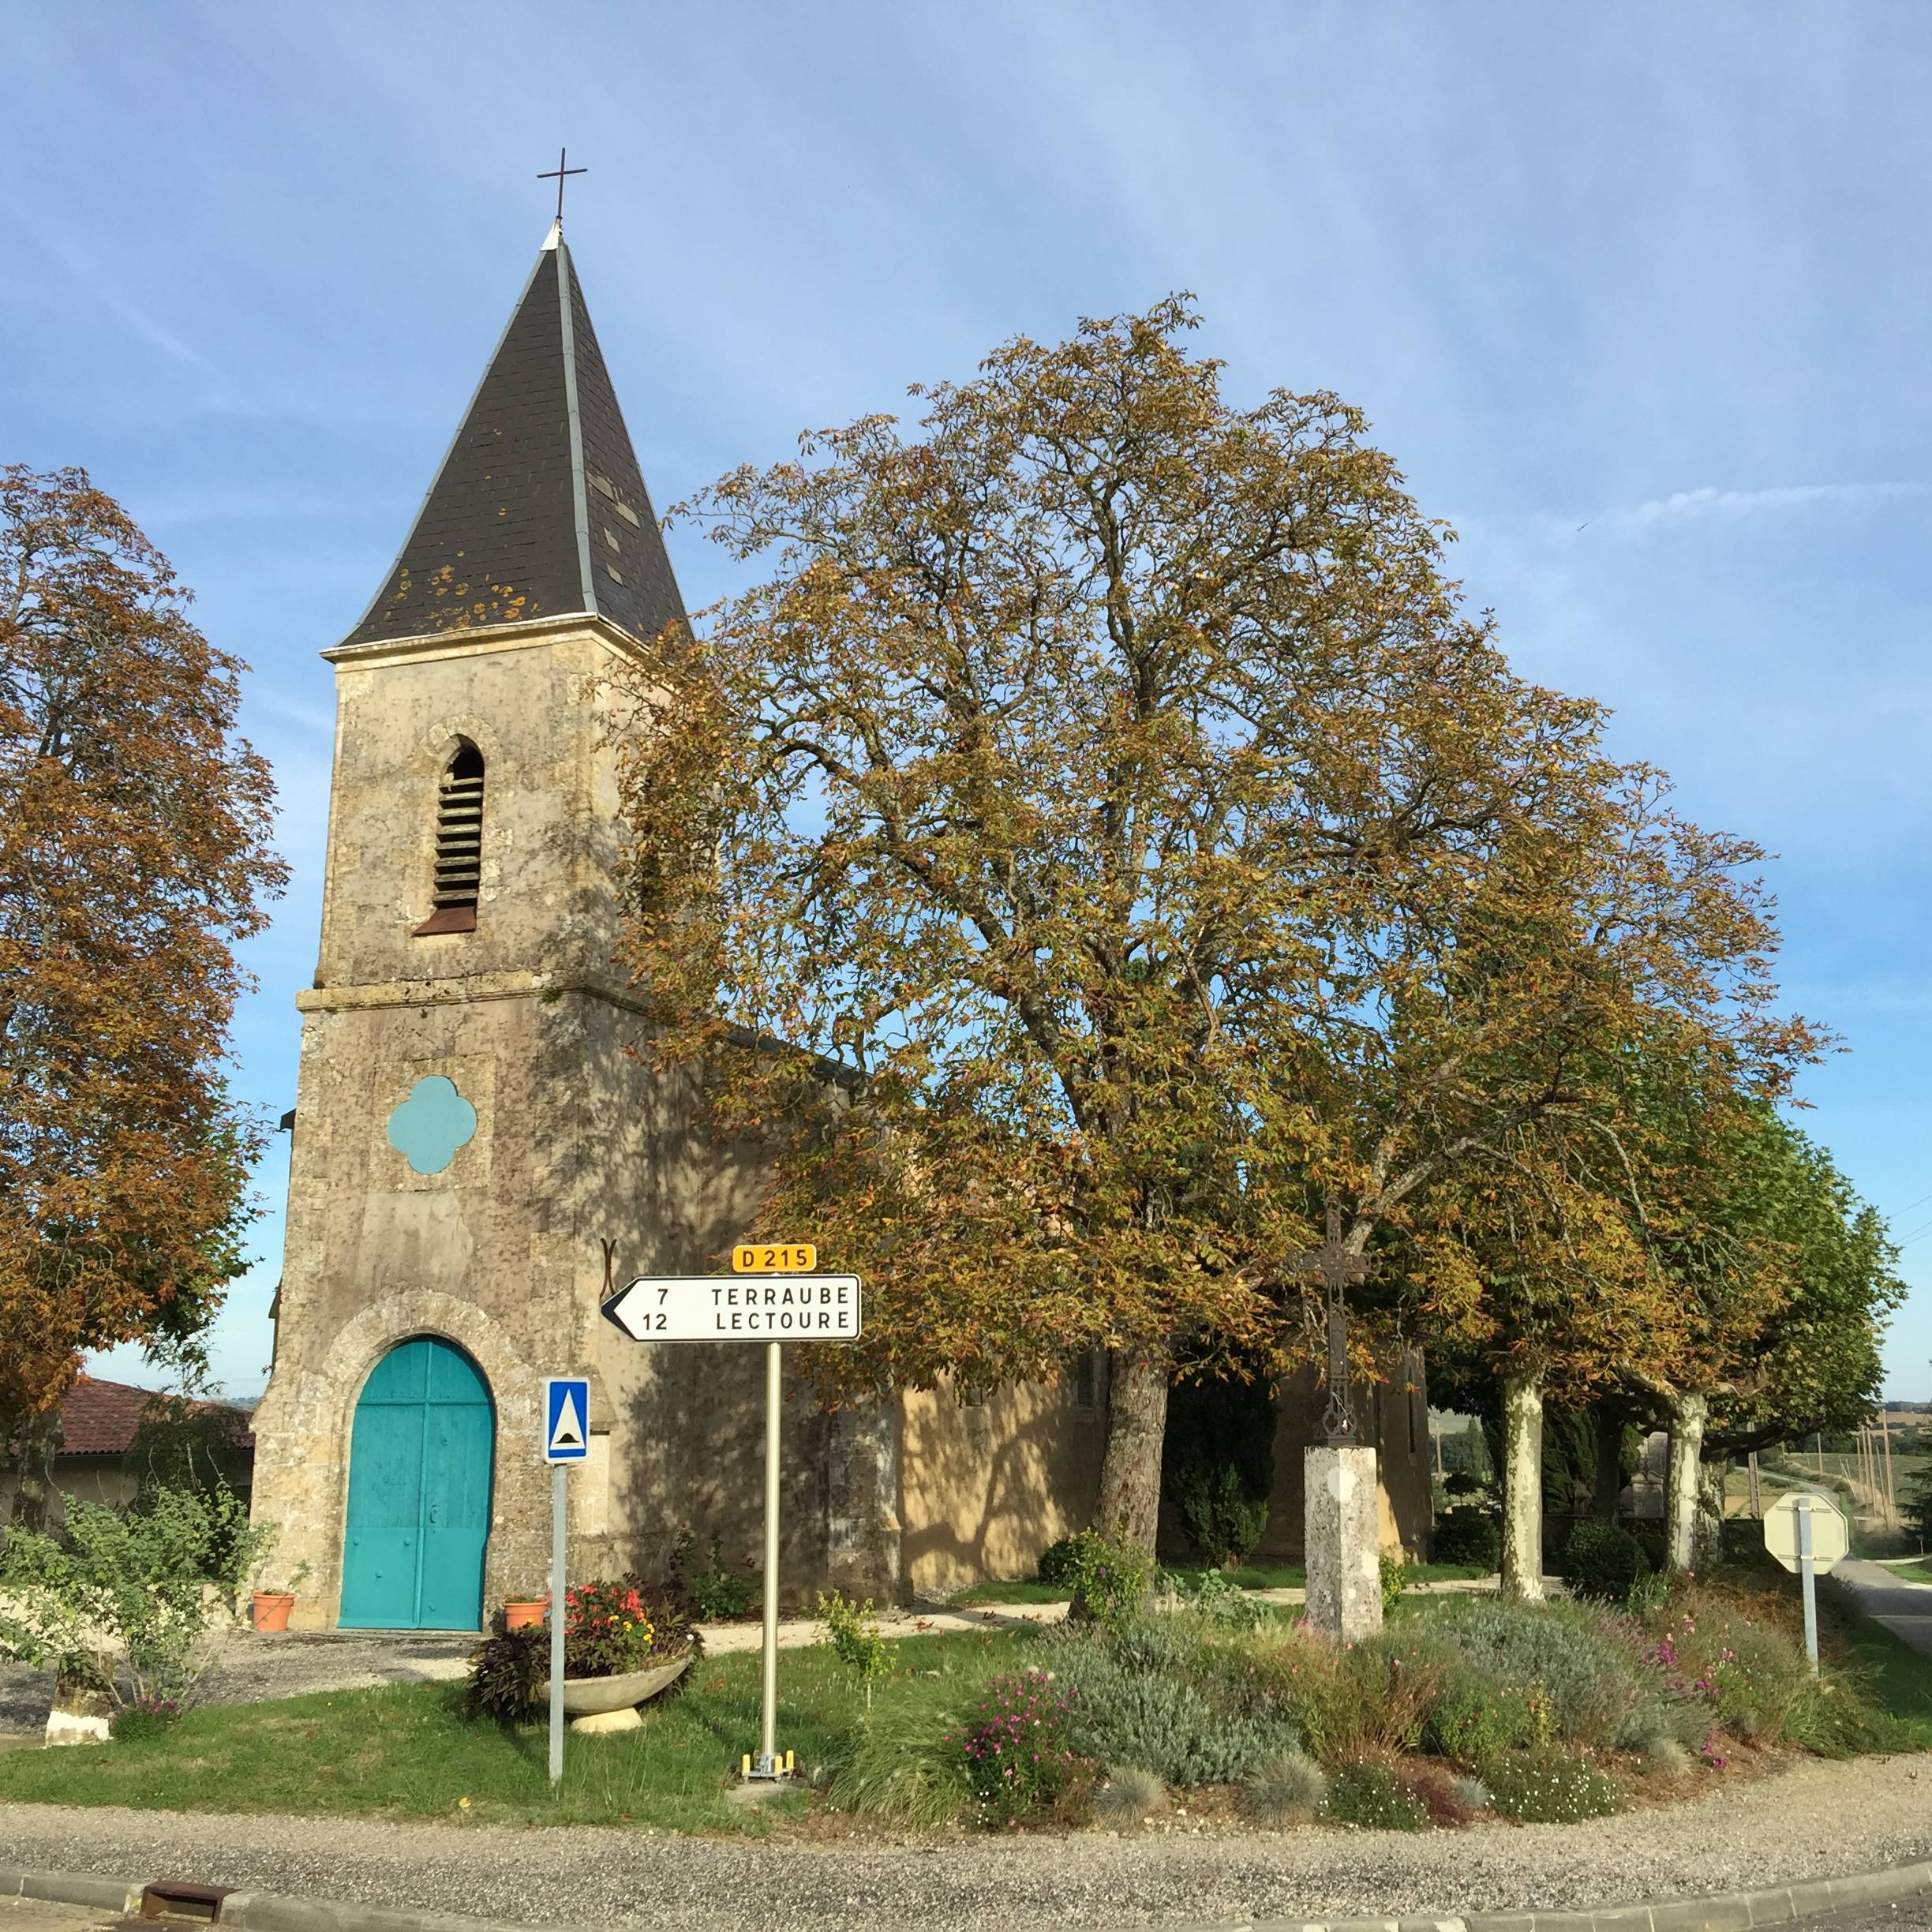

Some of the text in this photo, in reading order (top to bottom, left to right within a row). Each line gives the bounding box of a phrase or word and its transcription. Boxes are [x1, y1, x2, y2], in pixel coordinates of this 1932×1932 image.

[743, 1249, 807, 1267] D 215
[657, 1287, 848, 1305] 7 TERRAUBE
[642, 1312, 849, 1330] 12 LECTOURE
